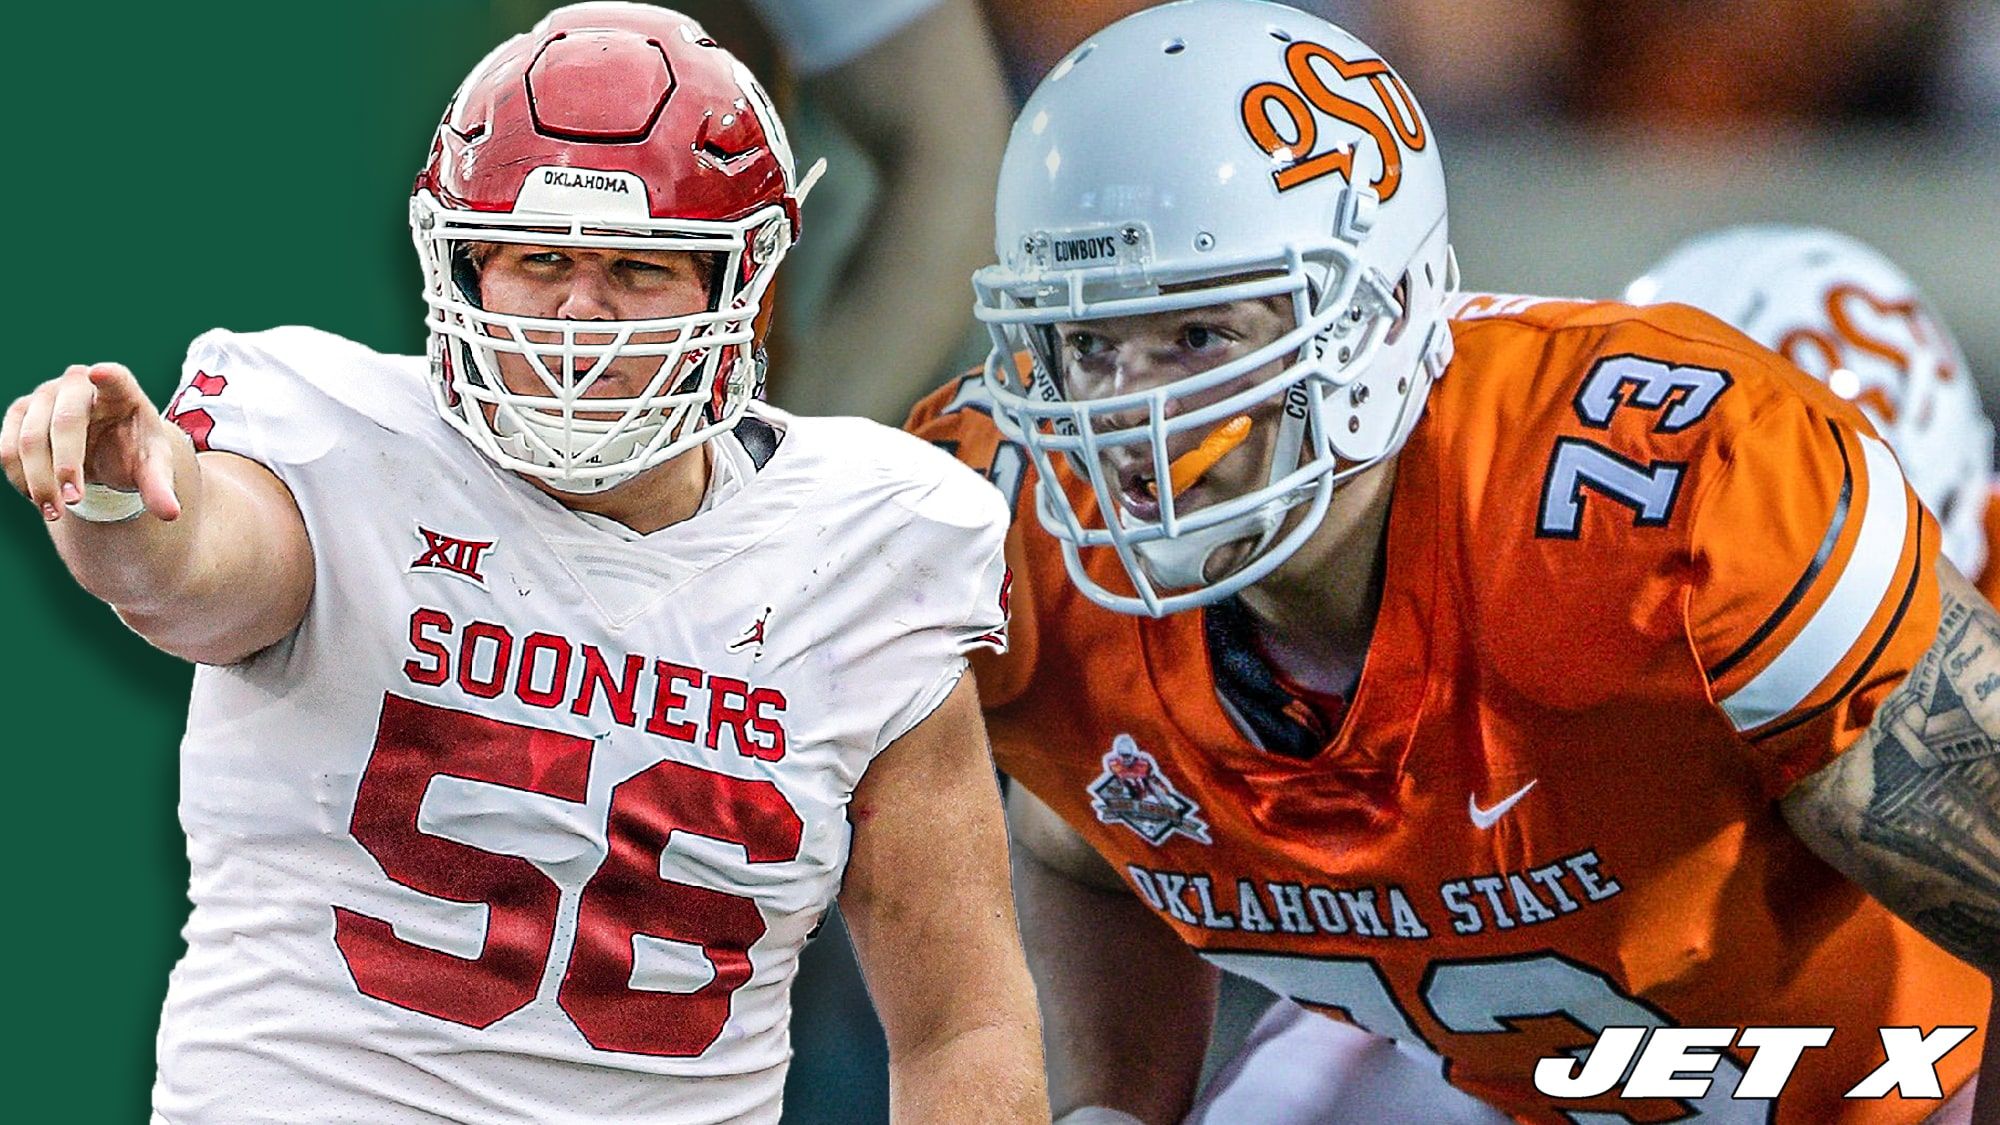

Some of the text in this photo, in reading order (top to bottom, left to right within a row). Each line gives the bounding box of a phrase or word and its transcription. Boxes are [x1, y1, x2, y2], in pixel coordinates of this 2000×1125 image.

[544, 170, 629, 194] OKLAHOMA
[1055, 236, 1116, 262] COWBOYS
[1535, 353, 1734, 540] 73
[402, 606, 788, 763] SOONERS
[330, 690, 804, 1058] 56
[1129, 846, 1624, 939] OKLAHOMA STATE
